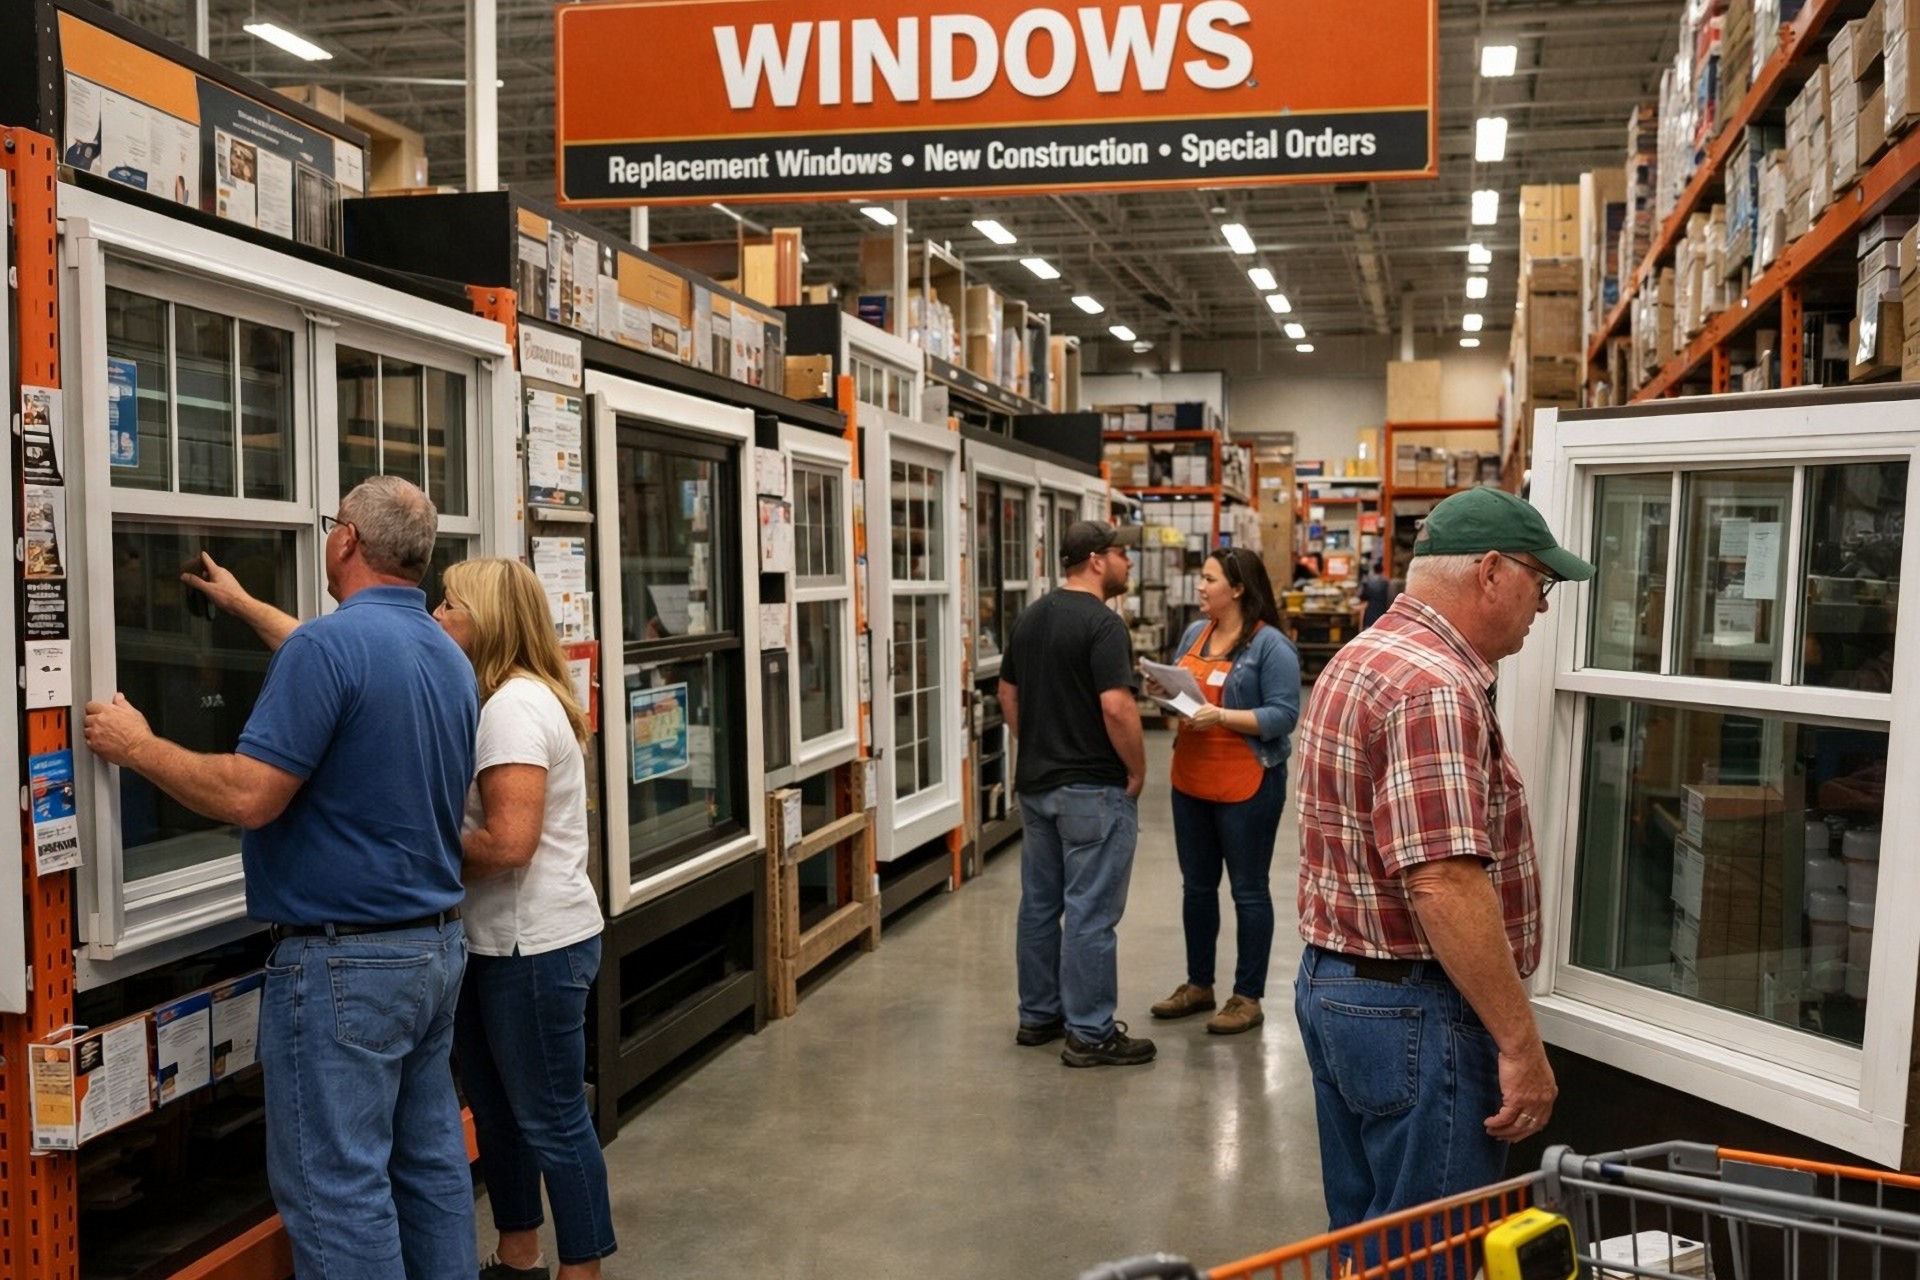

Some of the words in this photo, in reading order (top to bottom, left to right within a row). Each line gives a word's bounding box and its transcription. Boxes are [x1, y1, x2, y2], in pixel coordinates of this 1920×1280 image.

[713, 0, 1254, 109] WINDOWS
[608, 152, 770, 184] Replacement
[775, 146, 893, 177] Windows
[923, 143, 982, 172] New
[986, 136, 1149, 170] Construction
[1181, 128, 1279, 168] Special
[1285, 126, 1378, 159] Orders
